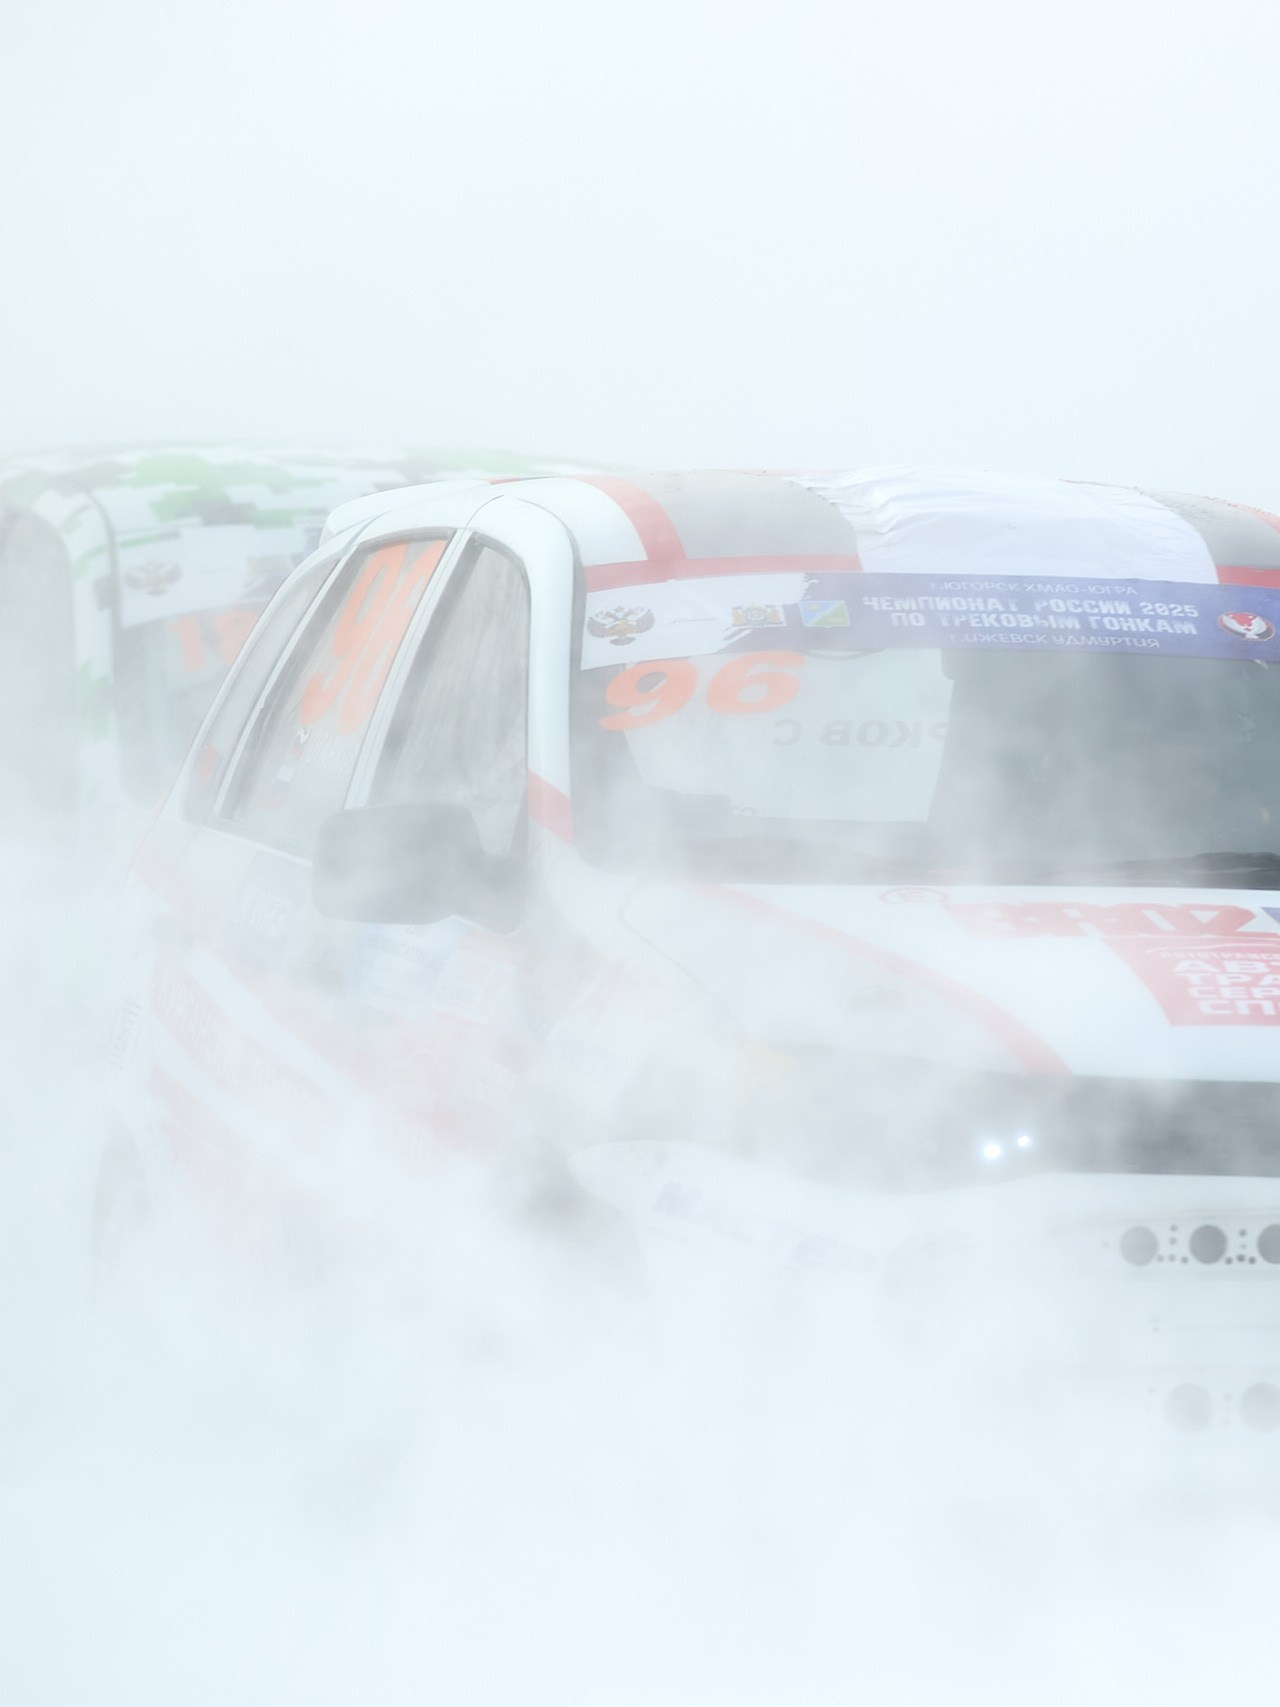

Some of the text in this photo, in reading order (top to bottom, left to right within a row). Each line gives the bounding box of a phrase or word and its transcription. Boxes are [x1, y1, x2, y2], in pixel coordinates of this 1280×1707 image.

[862, 595, 1199, 618] ЧЕМПИОНАТ РОССИИ 2025
[890, 611, 1198, 636] ПО ТРЕКОВЫМ ГОНКАМ
[599, 651, 807, 732] 96
